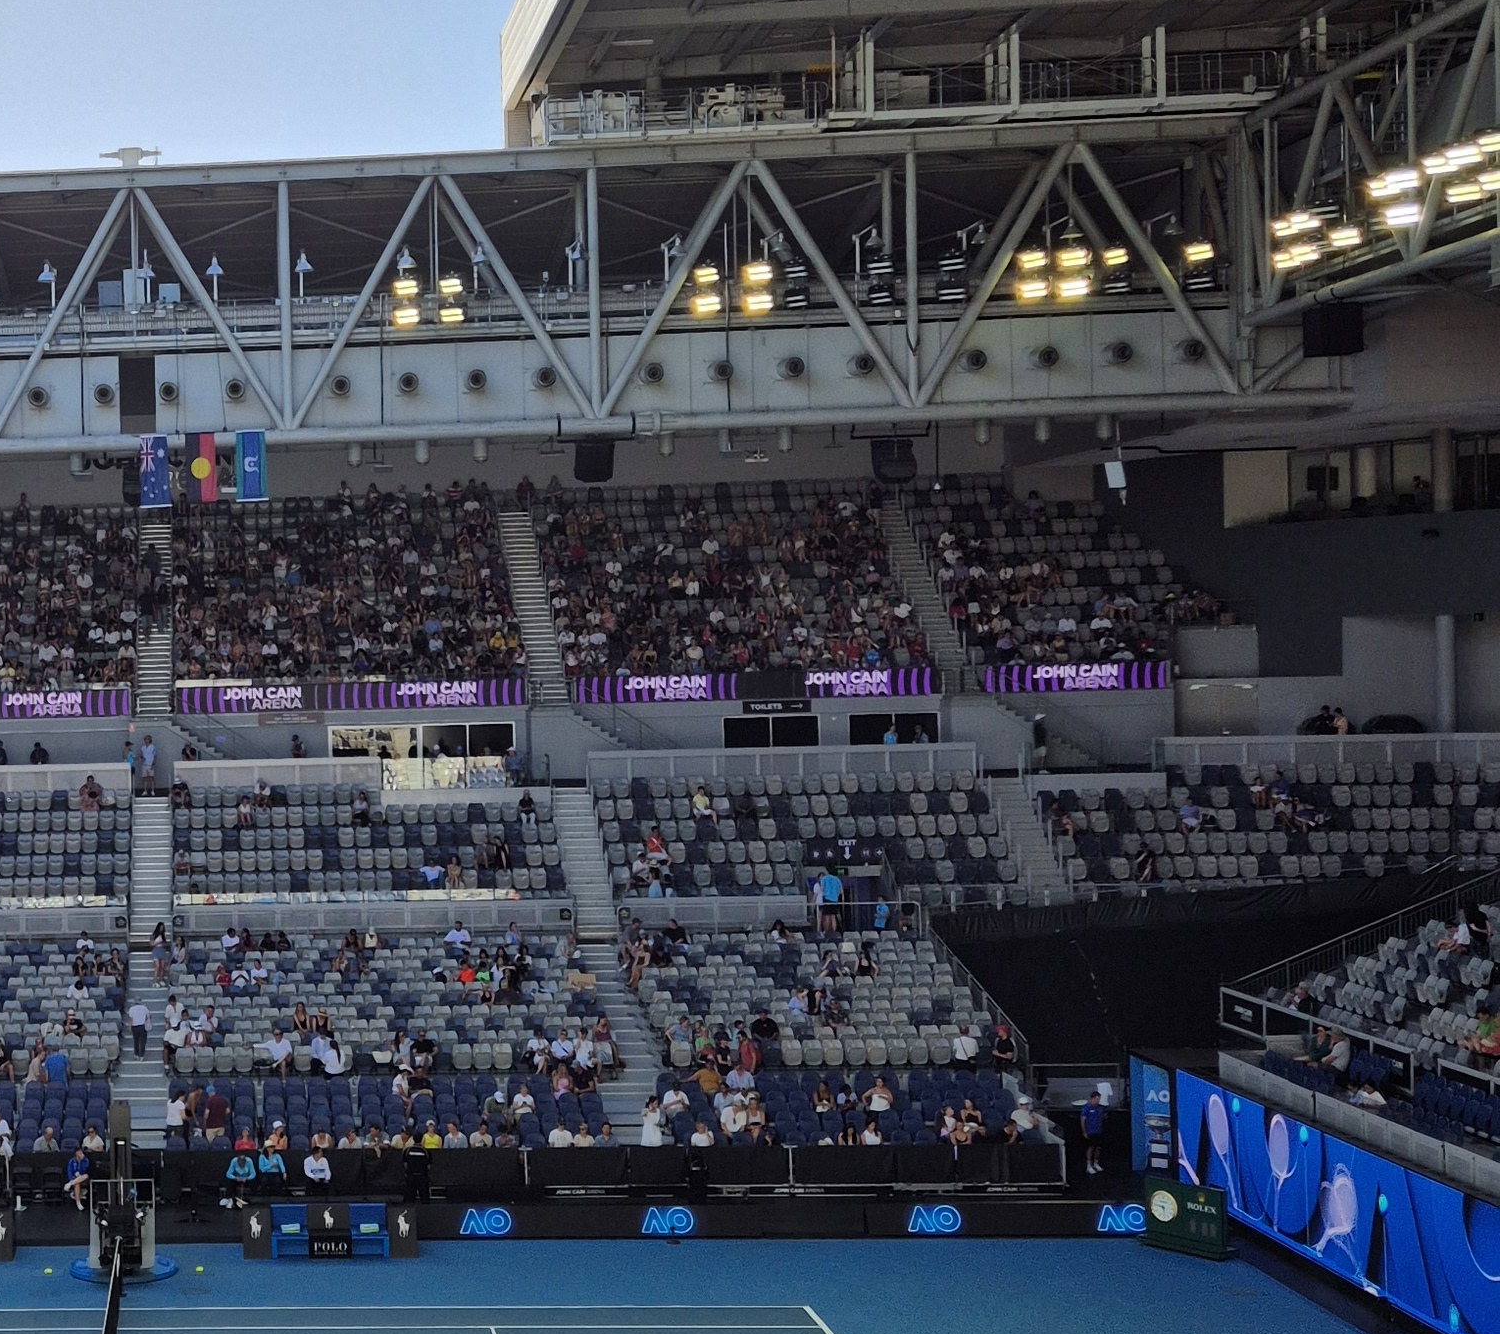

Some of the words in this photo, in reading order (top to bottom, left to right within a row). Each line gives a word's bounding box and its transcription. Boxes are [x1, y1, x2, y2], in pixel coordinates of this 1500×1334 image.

[805, 672, 847, 685] JOHN
[850, 671, 888, 684] CAIN
[1033, 666, 1076, 679] JOHN
[1079, 664, 1118, 677] CAIN
[397, 683, 438, 696] JOHN
[440, 681, 477, 694] CAIN
[624, 677, 666, 690] JOHN
[669, 676, 706, 689] CAIN
[1063, 676, 1119, 688] ARENA
[223, 688, 263, 700] JOHN
[265, 687, 301, 699] CAIN
[654, 688, 707, 700] ARENA
[834, 683, 888, 695] ARENA
[4, 693, 44, 706] JOHN
[46, 692, 82, 704] CAIN
[251, 698, 302, 709] ARENA
[425, 693, 478, 705] ARENA
[32, 703, 82, 715] ARENA
[750, 703, 782, 711] TOILETS
[1187, 1201, 1217, 1214] ROLEX
[460, 1207, 512, 1235] AO
[641, 1207, 694, 1234] AO
[908, 1205, 961, 1233] AO
[314, 1241, 348, 1252] POLO
